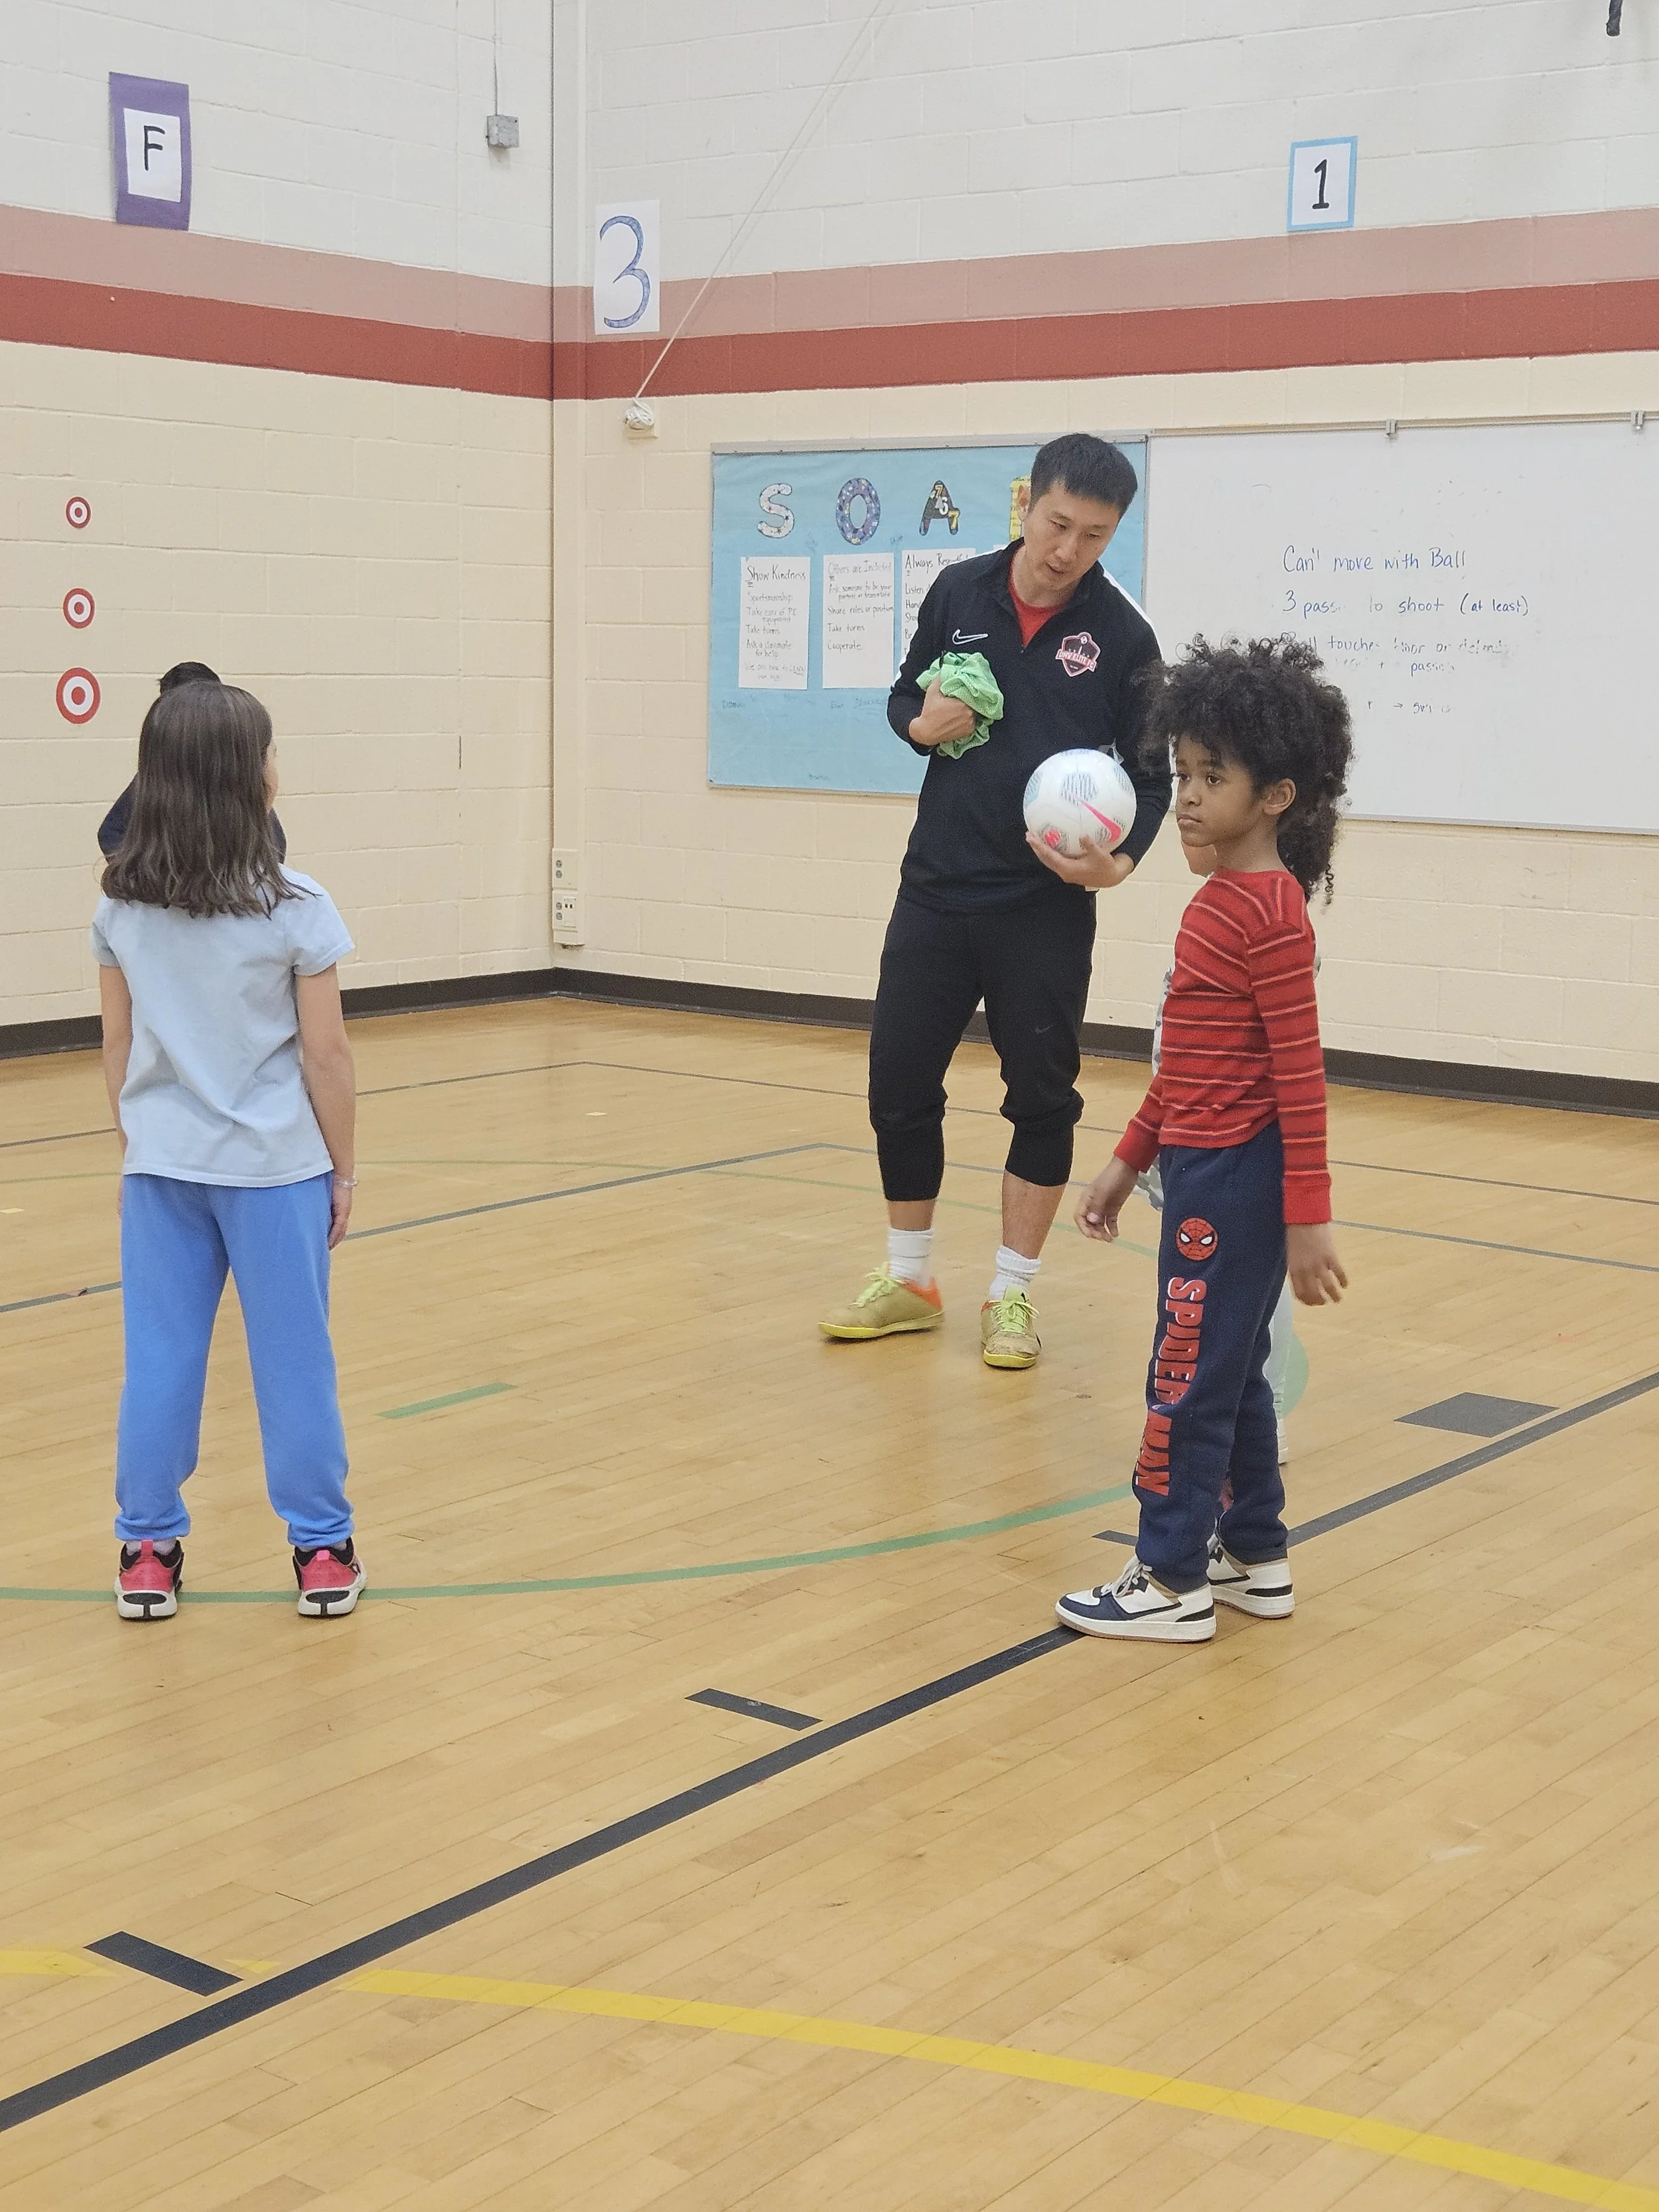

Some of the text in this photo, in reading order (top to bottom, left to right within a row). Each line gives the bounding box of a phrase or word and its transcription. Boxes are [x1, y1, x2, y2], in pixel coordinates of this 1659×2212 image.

[144, 125, 165, 171] F
[1312, 159, 1330, 210] 1
[599, 215, 651, 329] 3
[905, 554, 933, 573] Always
[1333, 556, 1374, 572] move
[1384, 548, 1419, 569] with
[1429, 546, 1465, 568] Ball
[745, 565, 806, 581] Show Kindness
[905, 583, 924, 595] Listen
[1283, 589, 1297, 612] 3
[1398, 597, 1445, 613] shoot
[746, 607, 762, 616] Take
[746, 625, 760, 633] Take
[827, 623, 842, 632] Take
[828, 640, 862, 654] Cooperate
[1154, 1277, 1207, 1404] SPIDER
